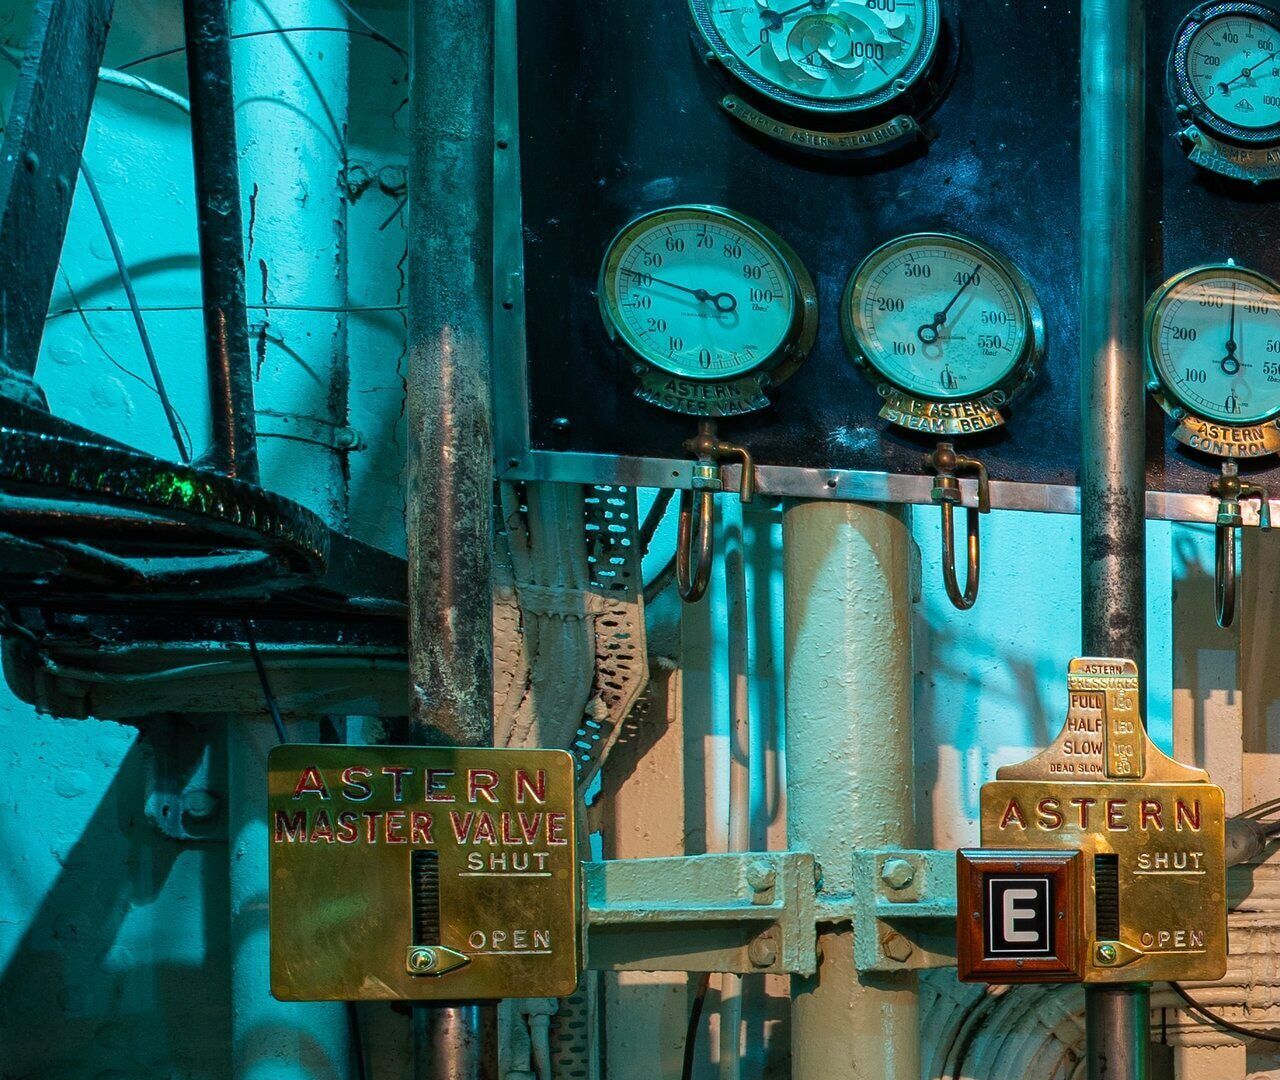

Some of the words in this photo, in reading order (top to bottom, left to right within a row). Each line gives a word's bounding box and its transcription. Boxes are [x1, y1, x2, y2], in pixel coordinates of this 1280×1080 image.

[666, 237, 684, 252] 60
[724, 243, 742, 259] 80
[743, 265, 761, 279] 90
[751, 288, 773, 303] 100
[878, 297, 904, 312] 200
[647, 318, 666, 332] 20
[981, 311, 1007, 325] 500
[1172, 326, 1197, 341] 200
[977, 335, 1002, 349] 550
[665, 379, 742, 398] ASTERN
[1197, 424, 1265, 443] ASTERN
[1188, 433, 1266, 456] CONTROL
[1084, 664, 1123, 674] ASTERN
[1071, 694, 1103, 709] FULL
[1067, 718, 1103, 732] HALF
[1063, 740, 1103, 755] SLOW
[1050, 763, 1075, 774] DEAD
[1078, 763, 1103, 774] SLOW
[291, 764, 547, 804] ASTERN
[999, 798, 1202, 834] ASTERN
[273, 810, 435, 844] MASTER
[449, 811, 568, 845] VALVE
[467, 851, 550, 872] SHUT
[1137, 852, 1204, 870] SHUT
[1002, 888, 1040, 942] E
[468, 929, 552, 949] OPEN
[1140, 930, 1205, 949] OPEN
